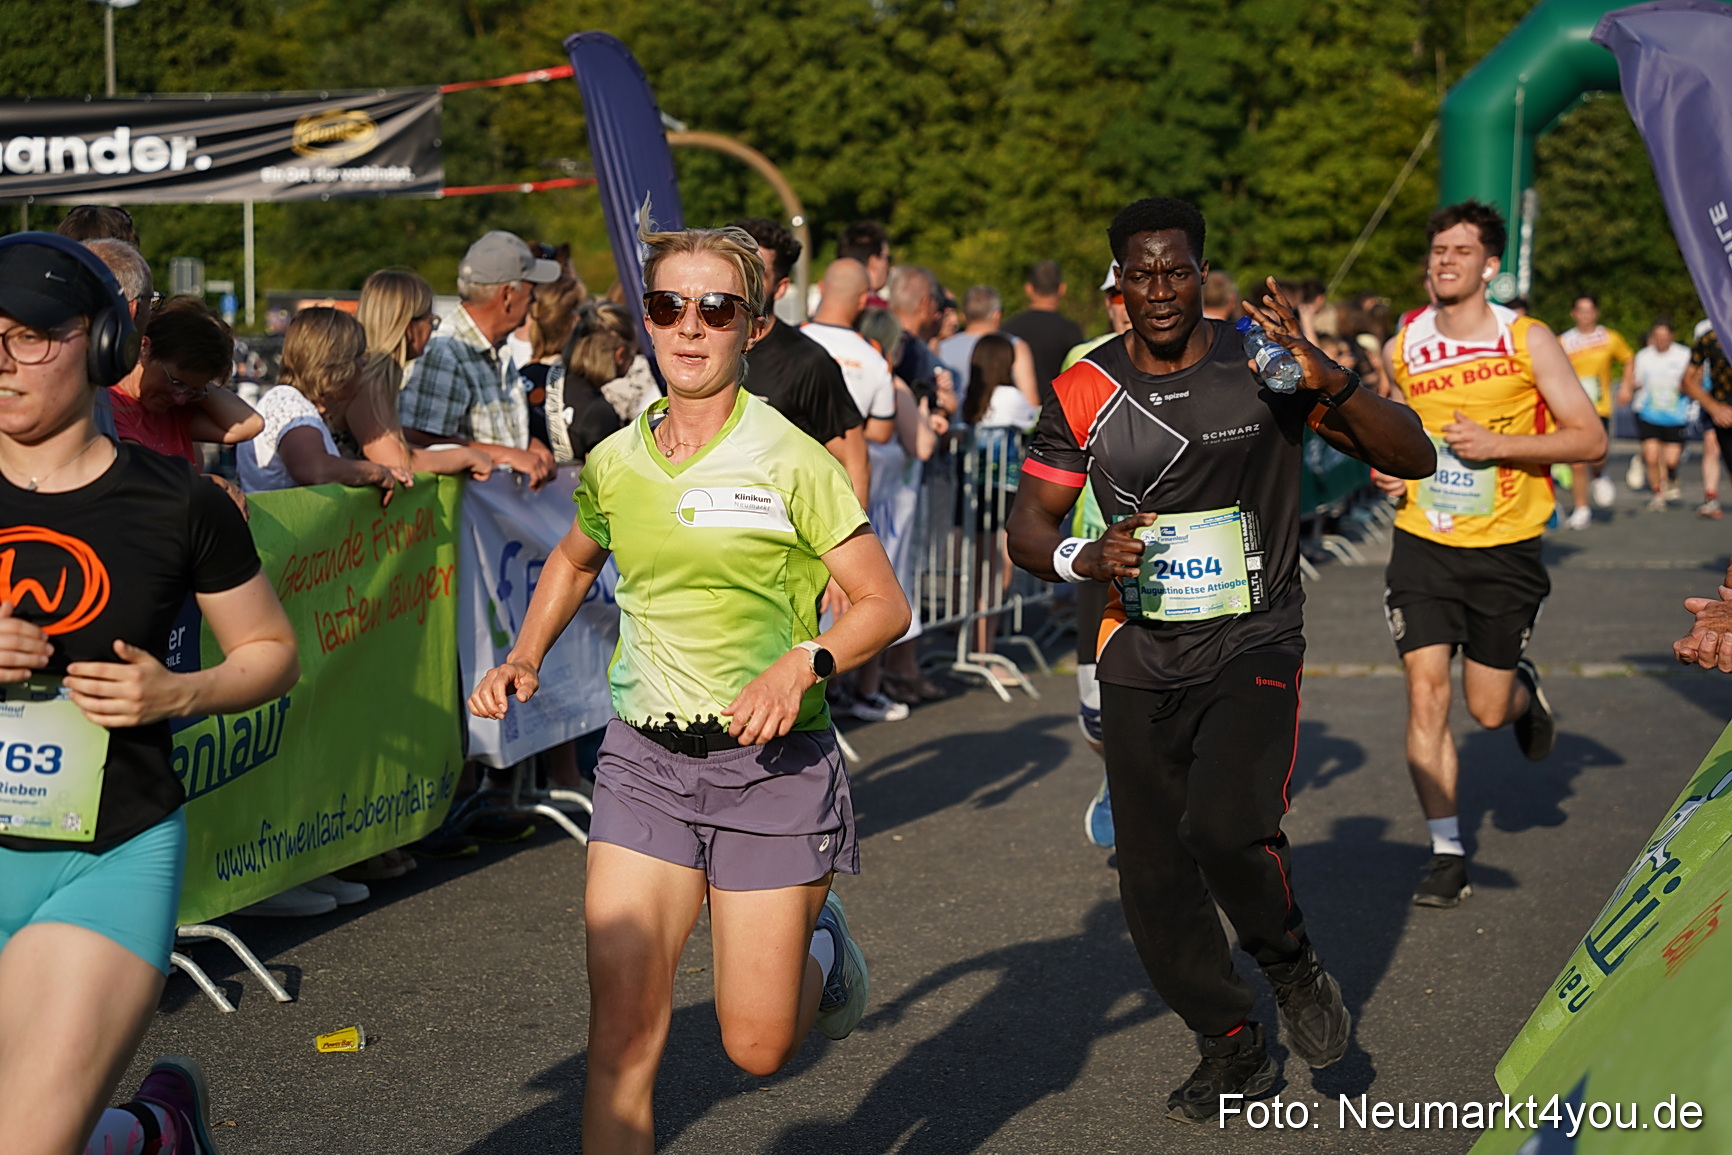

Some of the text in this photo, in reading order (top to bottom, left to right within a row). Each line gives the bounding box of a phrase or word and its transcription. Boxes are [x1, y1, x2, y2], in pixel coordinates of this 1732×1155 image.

[0, 126, 212, 174] ander.
[1409, 361, 1522, 398] MAX BÖGL
[1164, 390, 1190, 401] spized
[1202, 423, 1260, 441] SCHWARZ
[734, 502, 770, 511] Neumarkt
[735, 493, 771, 503] Klinikum
[276, 507, 437, 602] Gesunde Firmen
[1153, 556, 1222, 580] 2464
[1140, 585, 1183, 597] Augustino
[1184, 586, 1206, 595] Etse
[1207, 578, 1247, 593] Attiogbe
[1251, 572, 1260, 604] HILTL
[314, 585, 382, 655] laufen
[0, 741, 63, 775] 63
